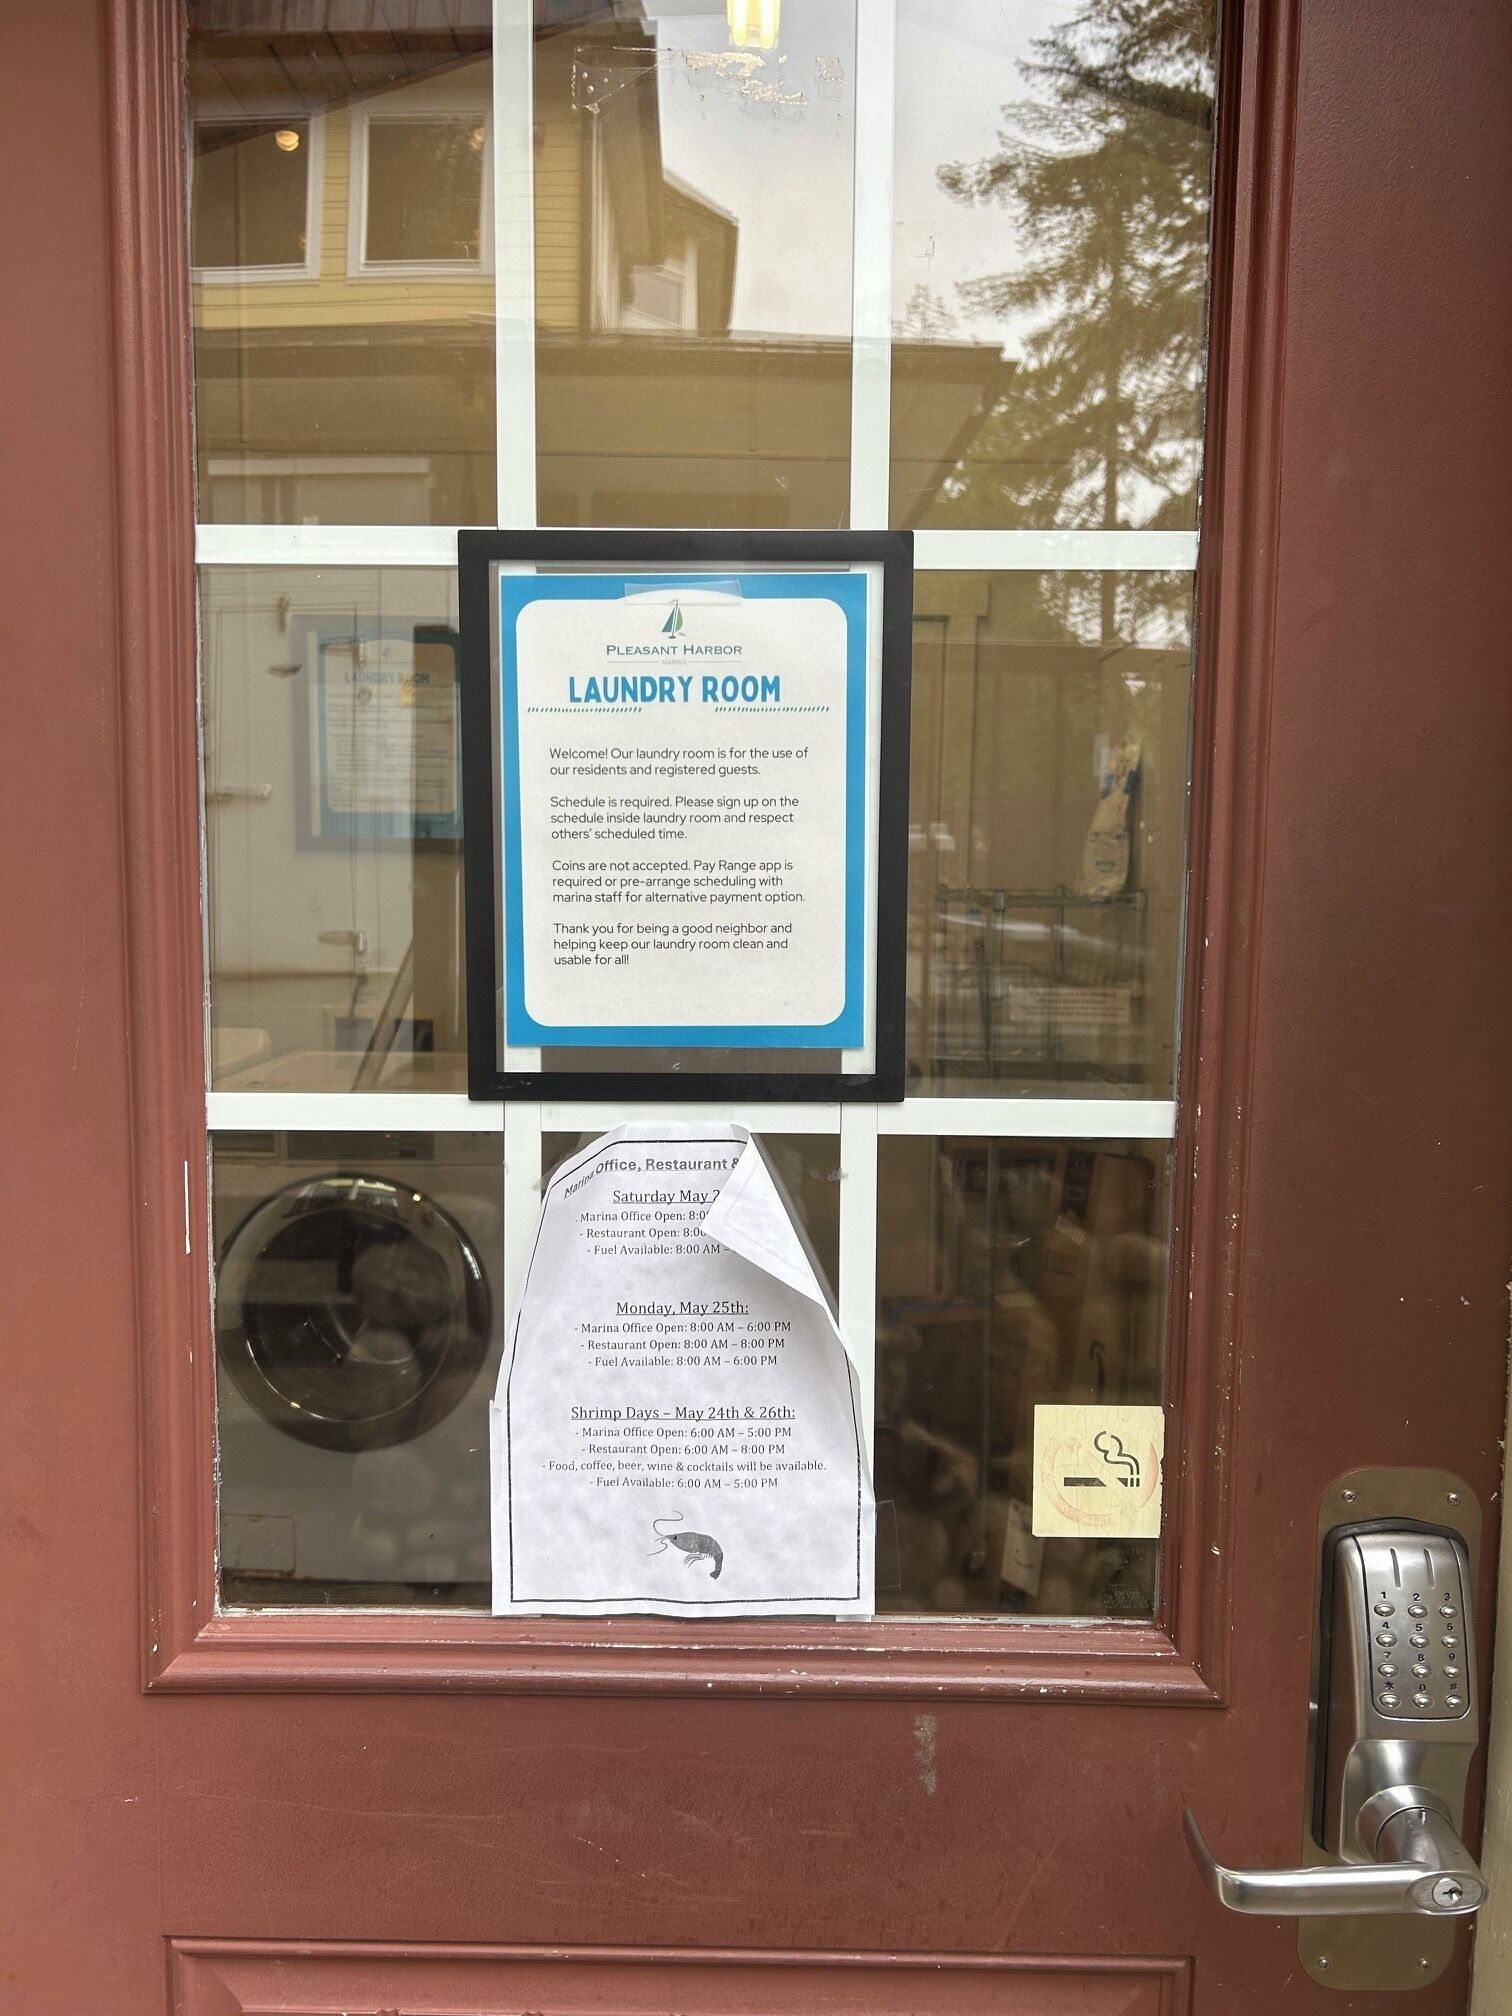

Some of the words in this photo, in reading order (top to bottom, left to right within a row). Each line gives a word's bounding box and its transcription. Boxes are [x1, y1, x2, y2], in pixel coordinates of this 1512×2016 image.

[606, 645, 678, 656] PLEASANT
[683, 644, 742, 655] HARBOR
[569, 676, 693, 703] LAUNDRY
[702, 675, 780, 703] ROOM
[549, 747, 608, 759] Welcome!
[610, 747, 634, 759] Our
[636, 747, 680, 762] laundry
[683, 750, 715, 759] room
[717, 747, 727, 759] is
[729, 747, 747, 759] for
[749, 747, 769, 759] the
[772, 750, 793, 759] use
[795, 747, 809, 759] of
[550, 766, 570, 775] our
[572, 764, 627, 775] residents
[629, 764, 652, 775] and
[655, 764, 716, 778] registered
[718, 764, 760, 778] guests.
[550, 796, 606, 807] Schedule
[608, 796, 617, 807] is
[620, 796, 672, 810] required.
[675, 796, 714, 807] Please
[717, 796, 741, 810] sign
[743, 798, 759, 809] up
[761, 798, 777, 807] on
[779, 795, 799, 807] the
[550, 812, 604, 824] schedule
[606, 812, 641, 823] inside
[643, 812, 687, 826] laundry
[689, 814, 721, 823] room
[724, 812, 746, 823] and
[749, 813, 794, 825] respect
[551, 828, 592, 839] others'
[594, 828, 655, 839] scheduled
[658, 828, 687, 839] time.
[552, 860, 586, 871] Coins
[588, 862, 607, 871] are
[610, 861, 630, 871] not
[632, 860, 691, 873] accepted.
[694, 859, 716, 874] Pay
[719, 859, 756, 873] Range
[759, 862, 782, 873] app
[784, 859, 793, 871] is
[552, 876, 602, 889] required
[604, 878, 617, 887] or
[620, 878, 691, 889] pre-arrange
[693, 875, 756, 889] scheduling
[758, 875, 783, 886] with
[553, 891, 592, 903] marina
[594, 891, 622, 903] staff
[625, 891, 643, 903] for
[645, 891, 707, 903] alternative
[710, 892, 762, 905] payment
[765, 891, 805, 904] option.
[553, 923, 590, 934] Thank
[592, 925, 614, 936] you
[616, 922, 634, 934] for
[637, 923, 669, 936] being
[672, 925, 679, 934] a
[681, 923, 713, 936] good
[715, 923, 768, 936] neighbor
[770, 922, 792, 934] and
[553, 939, 596, 952] helping
[599, 938, 629, 952] keep
[631, 941, 651, 949] our
[653, 938, 696, 952] laundry
[699, 941, 730, 949] room
[733, 938, 764, 949] clean
[766, 938, 788, 949] and
[554, 954, 592, 965] usable
[594, 953, 612, 965] for
[614, 954, 629, 965] all!
[564, 1170, 595, 1198] Marina
[595, 1158, 642, 1173] Office,
[646, 1158, 728, 1169] Restaurant
[613, 1189, 676, 1205] Saturday
[680, 1189, 710, 1205] May
[580, 1211, 618, 1223] Marina
[621, 1210, 651, 1221] Office
[654, 1211, 686, 1223] Open:
[688, 1210, 710, 1221] 8:0
[587, 1228, 646, 1238] Restaurant
[648, 1228, 680, 1239] Open:
[594, 1244, 617, 1255] Fuel
[620, 1243, 674, 1255] Available:
[675, 1244, 700, 1254] 8:00
[702, 1244, 720, 1254] AM
[617, 1301, 675, 1317] Monday,
[680, 1301, 709, 1316] May
[713, 1301, 748, 1313] 25th:
[581, 1323, 619, 1333] Marina
[622, 1322, 653, 1333] Office
[656, 1322, 687, 1335] Open:
[690, 1322, 714, 1332] 8:00
[716, 1322, 734, 1332] AM
[747, 1321, 771, 1332] 6:00
[774, 1321, 791, 1331] PM
[588, 1340, 647, 1350] Restaurant
[649, 1339, 681, 1351] Open:
[684, 1339, 708, 1349] 8:00
[710, 1339, 728, 1349] AM
[740, 1338, 765, 1349] 8:00
[768, 1338, 784, 1348] PM
[595, 1356, 618, 1367] Fuel
[620, 1355, 673, 1367] Available:
[676, 1355, 700, 1366] 8:00
[703, 1356, 721, 1366] AM
[733, 1355, 757, 1366] 6:00
[761, 1355, 777, 1365] PM
[571, 1406, 622, 1421] Shrimp
[626, 1406, 659, 1421] Days
[675, 1406, 704, 1421] May
[708, 1406, 739, 1418] 24th
[744, 1406, 754, 1418] &
[759, 1406, 795, 1418] 26th:
[582, 1427, 620, 1437] Marina
[623, 1427, 654, 1437] Office
[656, 1427, 687, 1440] Open:
[690, 1428, 714, 1438] 6:00
[717, 1427, 735, 1438] AM
[747, 1427, 771, 1438] 5:00
[775, 1427, 791, 1437] PM
[589, 1444, 647, 1454] Restaurant
[650, 1444, 681, 1457] Open:
[684, 1445, 708, 1455] 6:00
[711, 1444, 728, 1455] AM
[741, 1444, 765, 1455] 8:00
[768, 1444, 785, 1454] PM
[549, 1460, 578, 1472] Food,
[580, 1460, 615, 1471] coffee,
[617, 1460, 644, 1472] beer,
[647, 1462, 673, 1471] wine
[676, 1461, 684, 1472] &
[687, 1461, 734, 1472] cocktails
[736, 1461, 756, 1471] will
[760, 1461, 772, 1471] be
[775, 1460, 826, 1471] available.
[597, 1477, 619, 1487] Fuel
[622, 1477, 674, 1488] Available:
[677, 1478, 701, 1488] 6:00
[704, 1478, 721, 1489] AM
[734, 1478, 758, 1489] 5:00
[761, 1478, 778, 1488] PM
[1380, 1591, 1387, 1599] 1
[1412, 1593, 1421, 1601] 2
[1444, 1592, 1451, 1601] 3
[1382, 1621, 1390, 1630] 4
[1415, 1623, 1423, 1632] 5
[1446, 1622, 1454, 1631] 6
[1418, 1653, 1425, 1662] 8
[1448, 1652, 1455, 1661] 9
